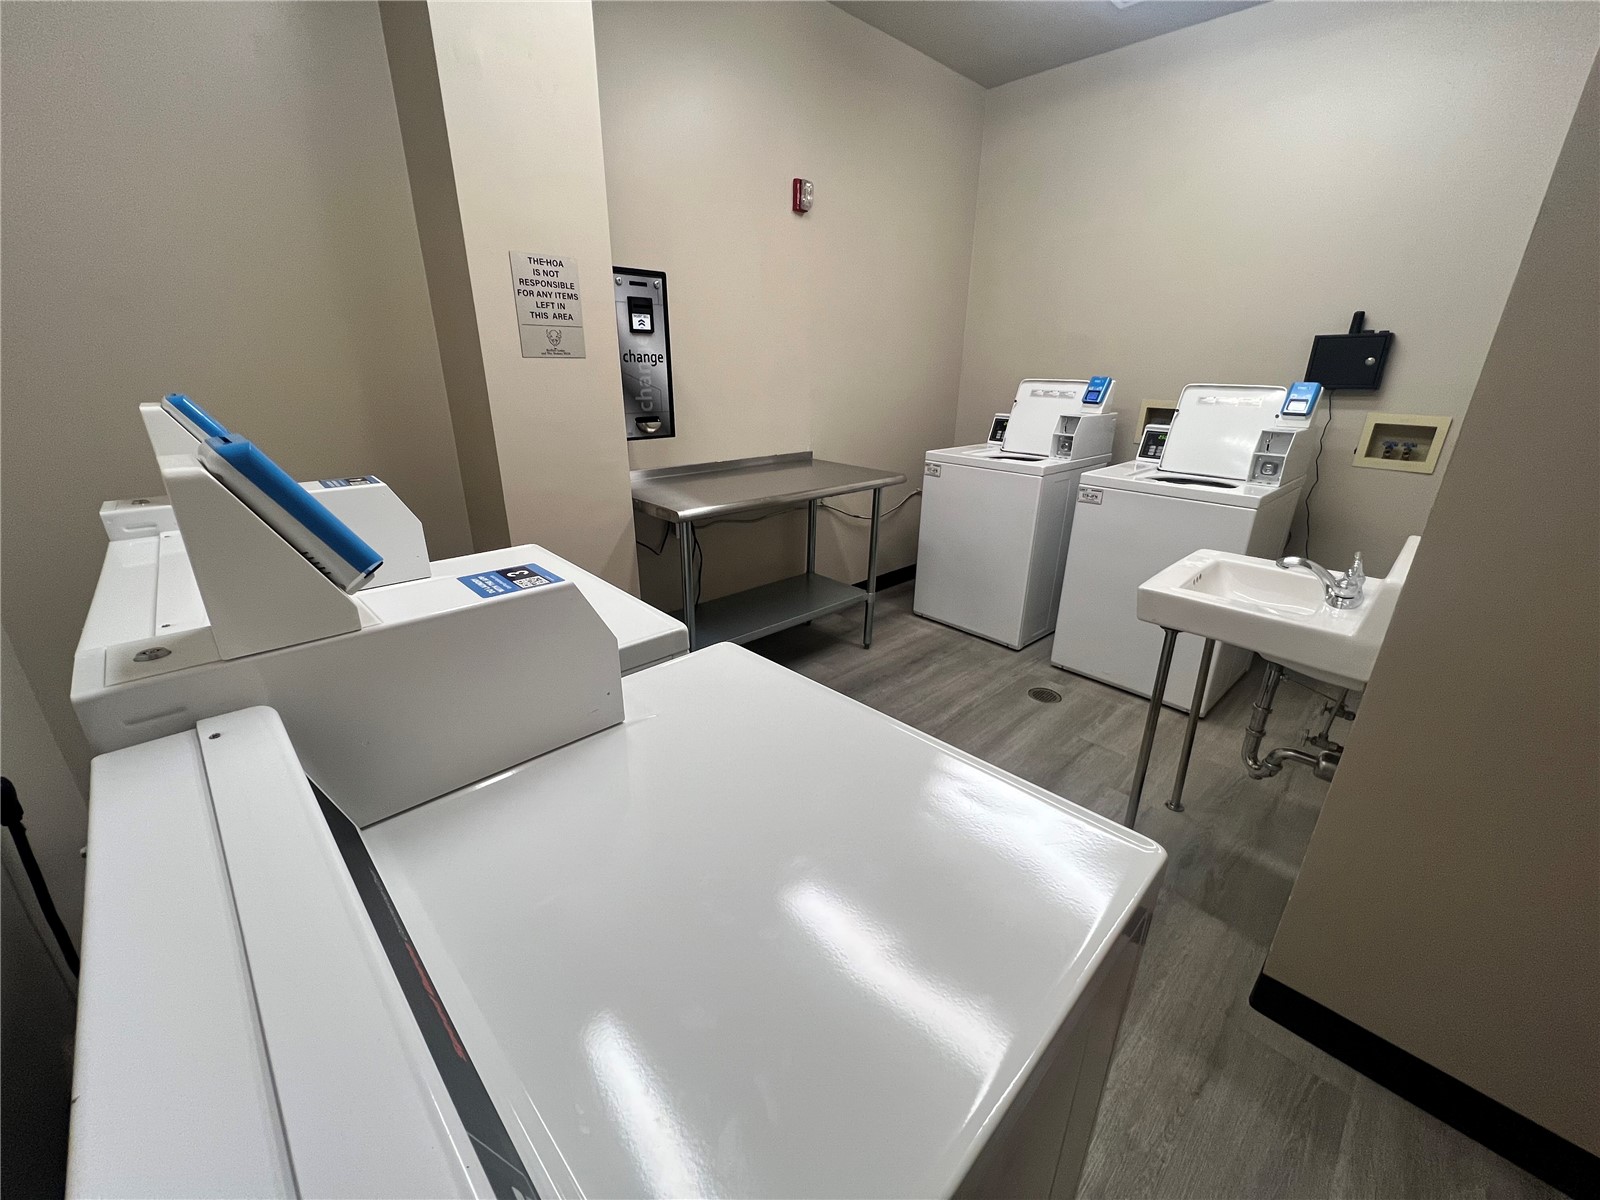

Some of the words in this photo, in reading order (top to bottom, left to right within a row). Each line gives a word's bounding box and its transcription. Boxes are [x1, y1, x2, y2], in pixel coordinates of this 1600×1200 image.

[543, 270, 559, 278] NOT
[519, 278, 575, 290] RESPONSIBLE
[517, 289, 534, 297] FOR
[555, 292, 579, 300] ITEMS
[536, 301, 555, 309] LEFT
[557, 302, 565, 310] IN
[530, 311, 549, 319] THIS
[552, 313, 574, 321] AREA
[623, 349, 664, 367] change
